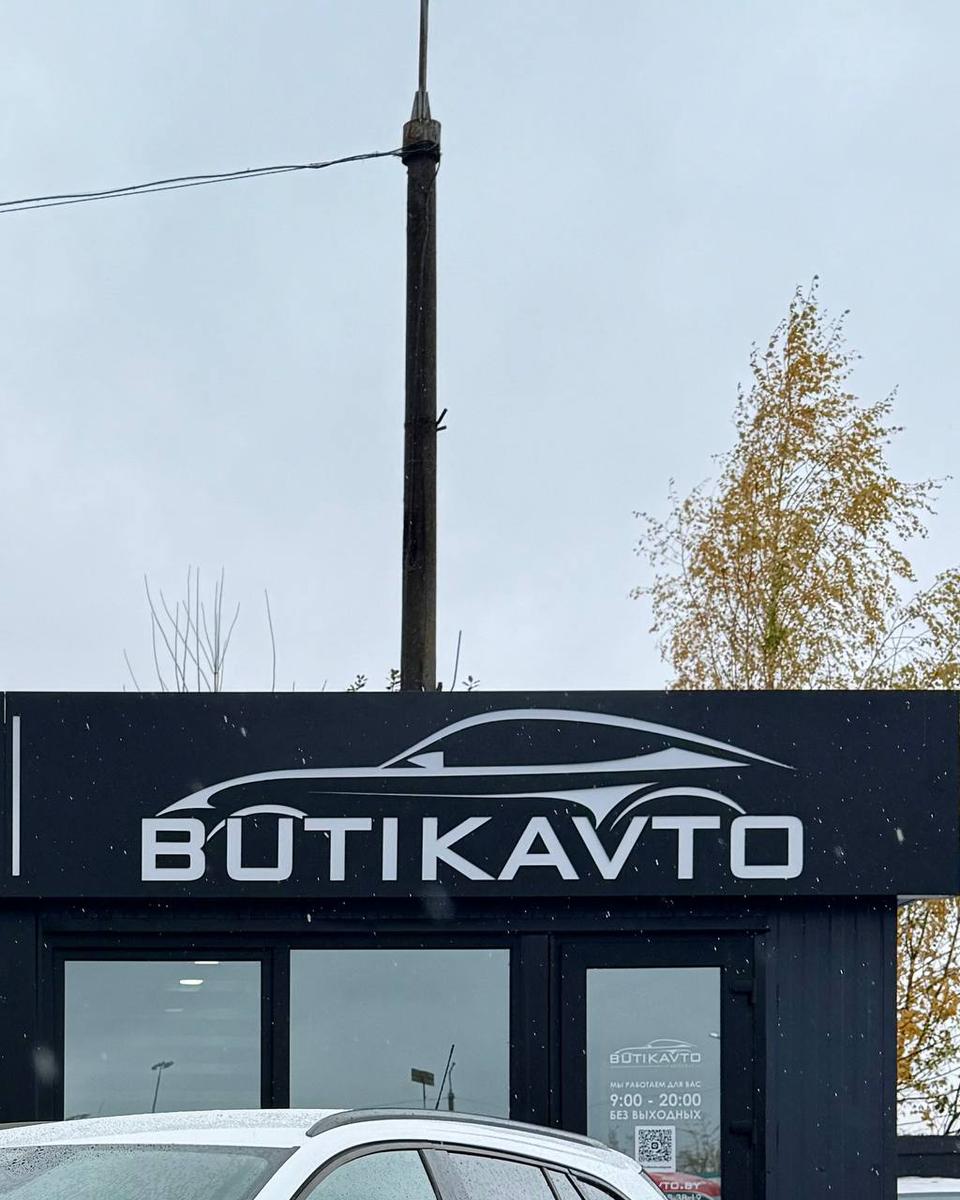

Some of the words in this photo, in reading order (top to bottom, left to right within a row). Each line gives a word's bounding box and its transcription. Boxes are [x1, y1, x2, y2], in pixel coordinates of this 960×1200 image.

[141, 816, 804, 881] BUTIKAVTO
[610, 1053, 701, 1064] BUTIKAVTO
[610, 1093, 642, 1107] 9:00
[659, 1093, 701, 1107] 20:00
[610, 1110, 629, 1120] БЕЗ
[632, 1110, 701, 1120] ВЫХОДНЫХ
